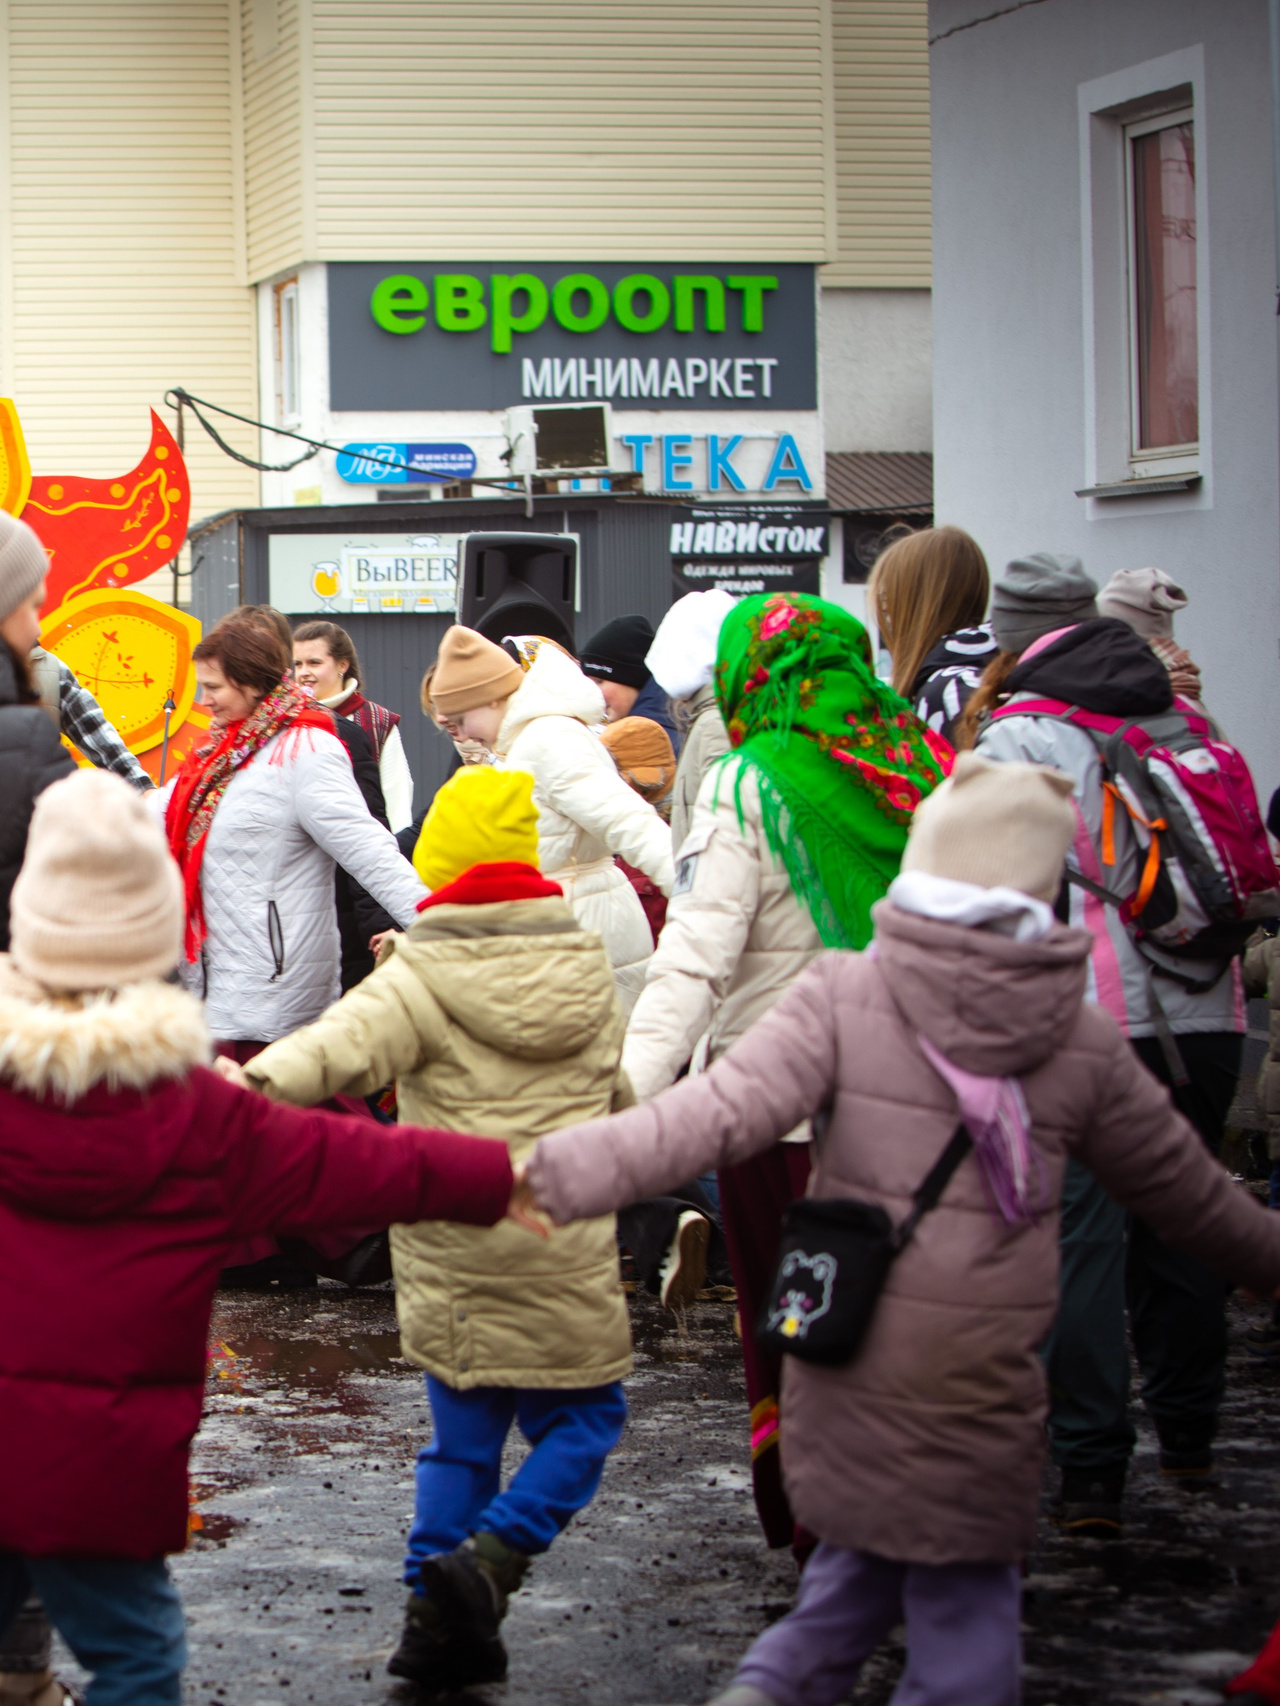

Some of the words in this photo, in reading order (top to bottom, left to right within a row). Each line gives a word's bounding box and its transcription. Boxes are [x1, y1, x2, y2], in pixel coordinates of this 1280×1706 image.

[371, 273, 779, 353] евроопт
[522, 357, 779, 398] МИНИМАРКЕТ
[506, 434, 813, 491] ТЕКА
